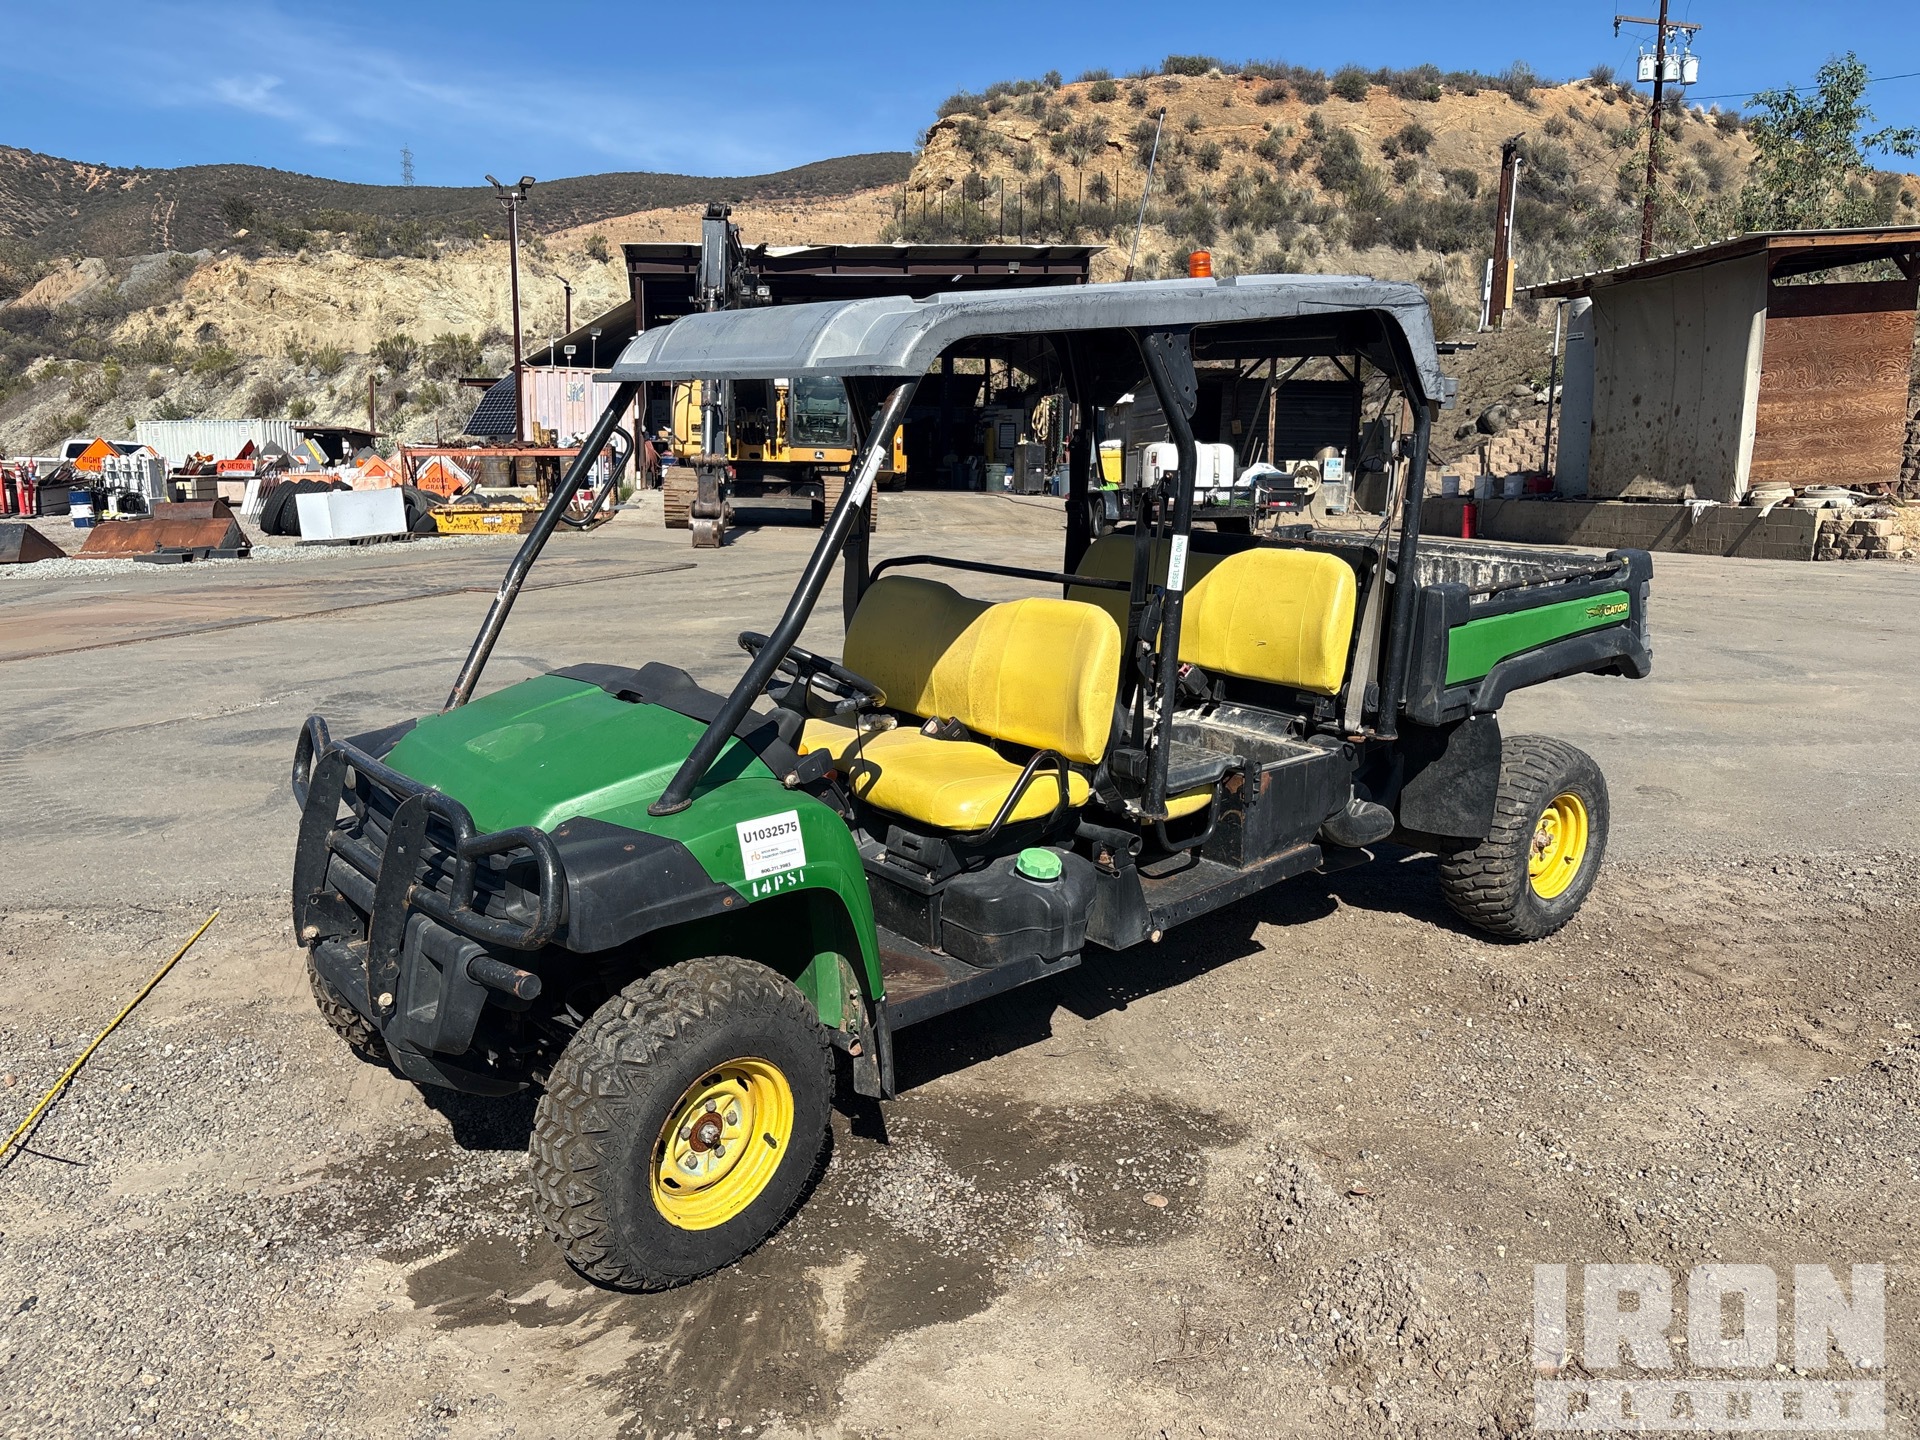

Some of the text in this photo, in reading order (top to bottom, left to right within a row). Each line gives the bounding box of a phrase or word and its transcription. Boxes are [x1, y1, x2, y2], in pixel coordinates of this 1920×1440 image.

[227, 462, 251, 470] DETOUR
[1171, 537, 1183, 589] DIESEL FUEL ONLY
[1604, 602, 1628, 616] GATOR
[743, 821, 798, 843] U1032575
